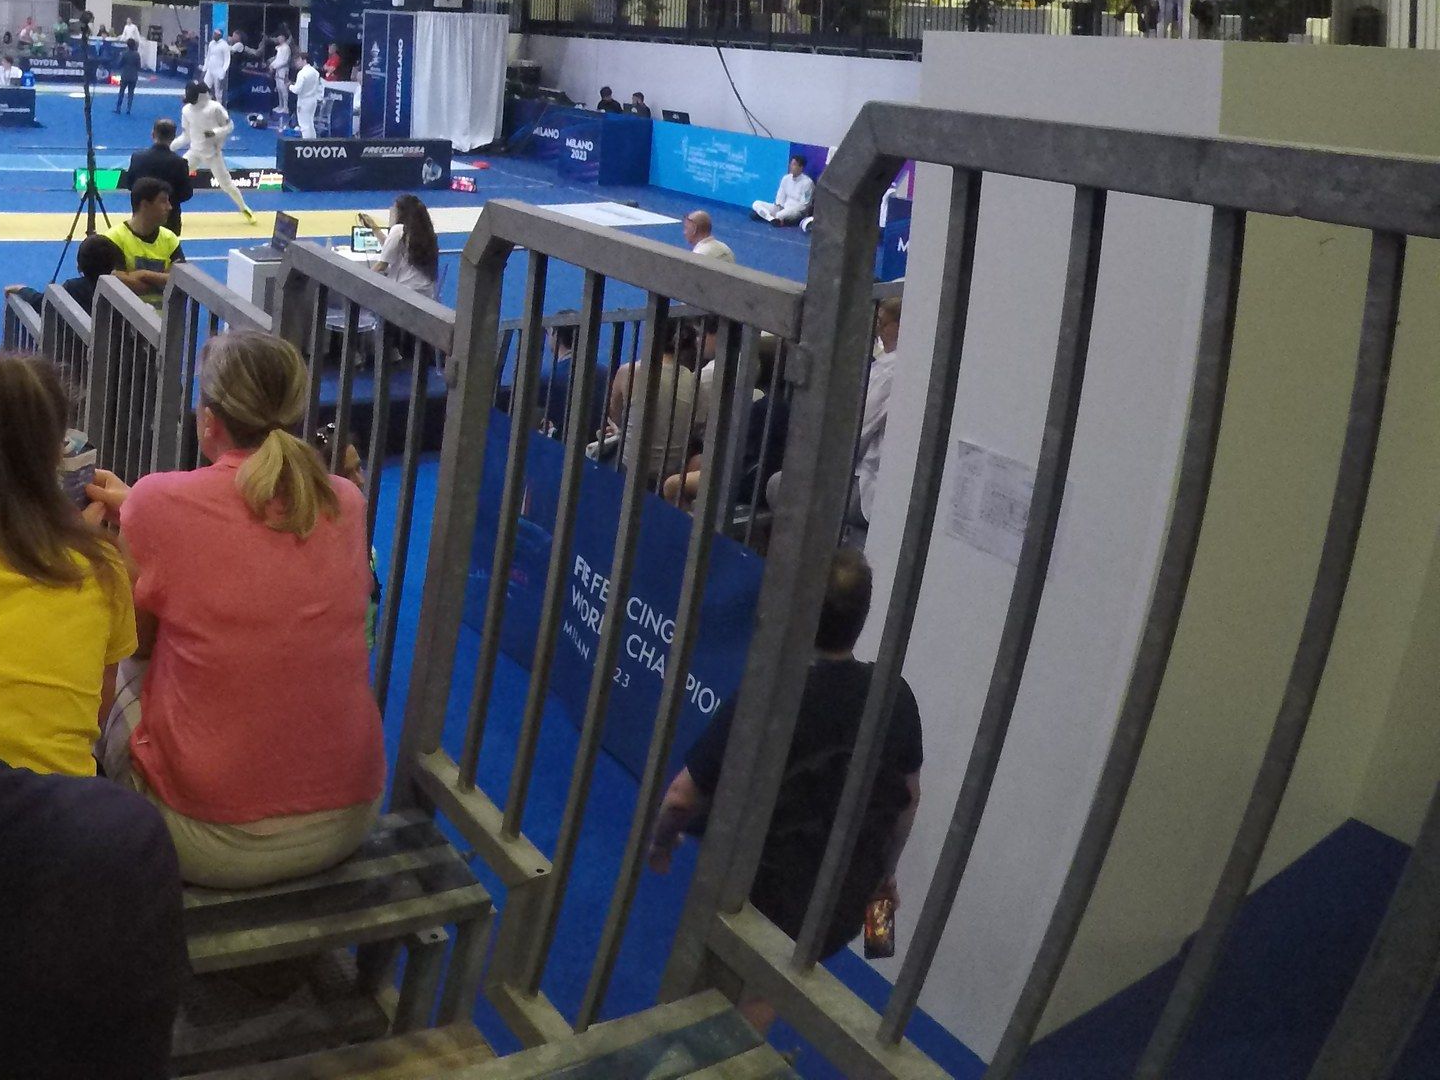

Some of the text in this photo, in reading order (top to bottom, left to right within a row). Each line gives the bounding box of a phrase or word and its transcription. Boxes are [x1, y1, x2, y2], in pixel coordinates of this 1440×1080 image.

[29, 58, 58, 67] TOYOTA
[565, 137, 594, 152] MILANO
[295, 146, 425, 159] TOYOTA FRECCIAROSSA
[570, 149, 587, 161] 2023
[572, 584, 606, 635] WORL
[590, 572, 676, 645] FECING
